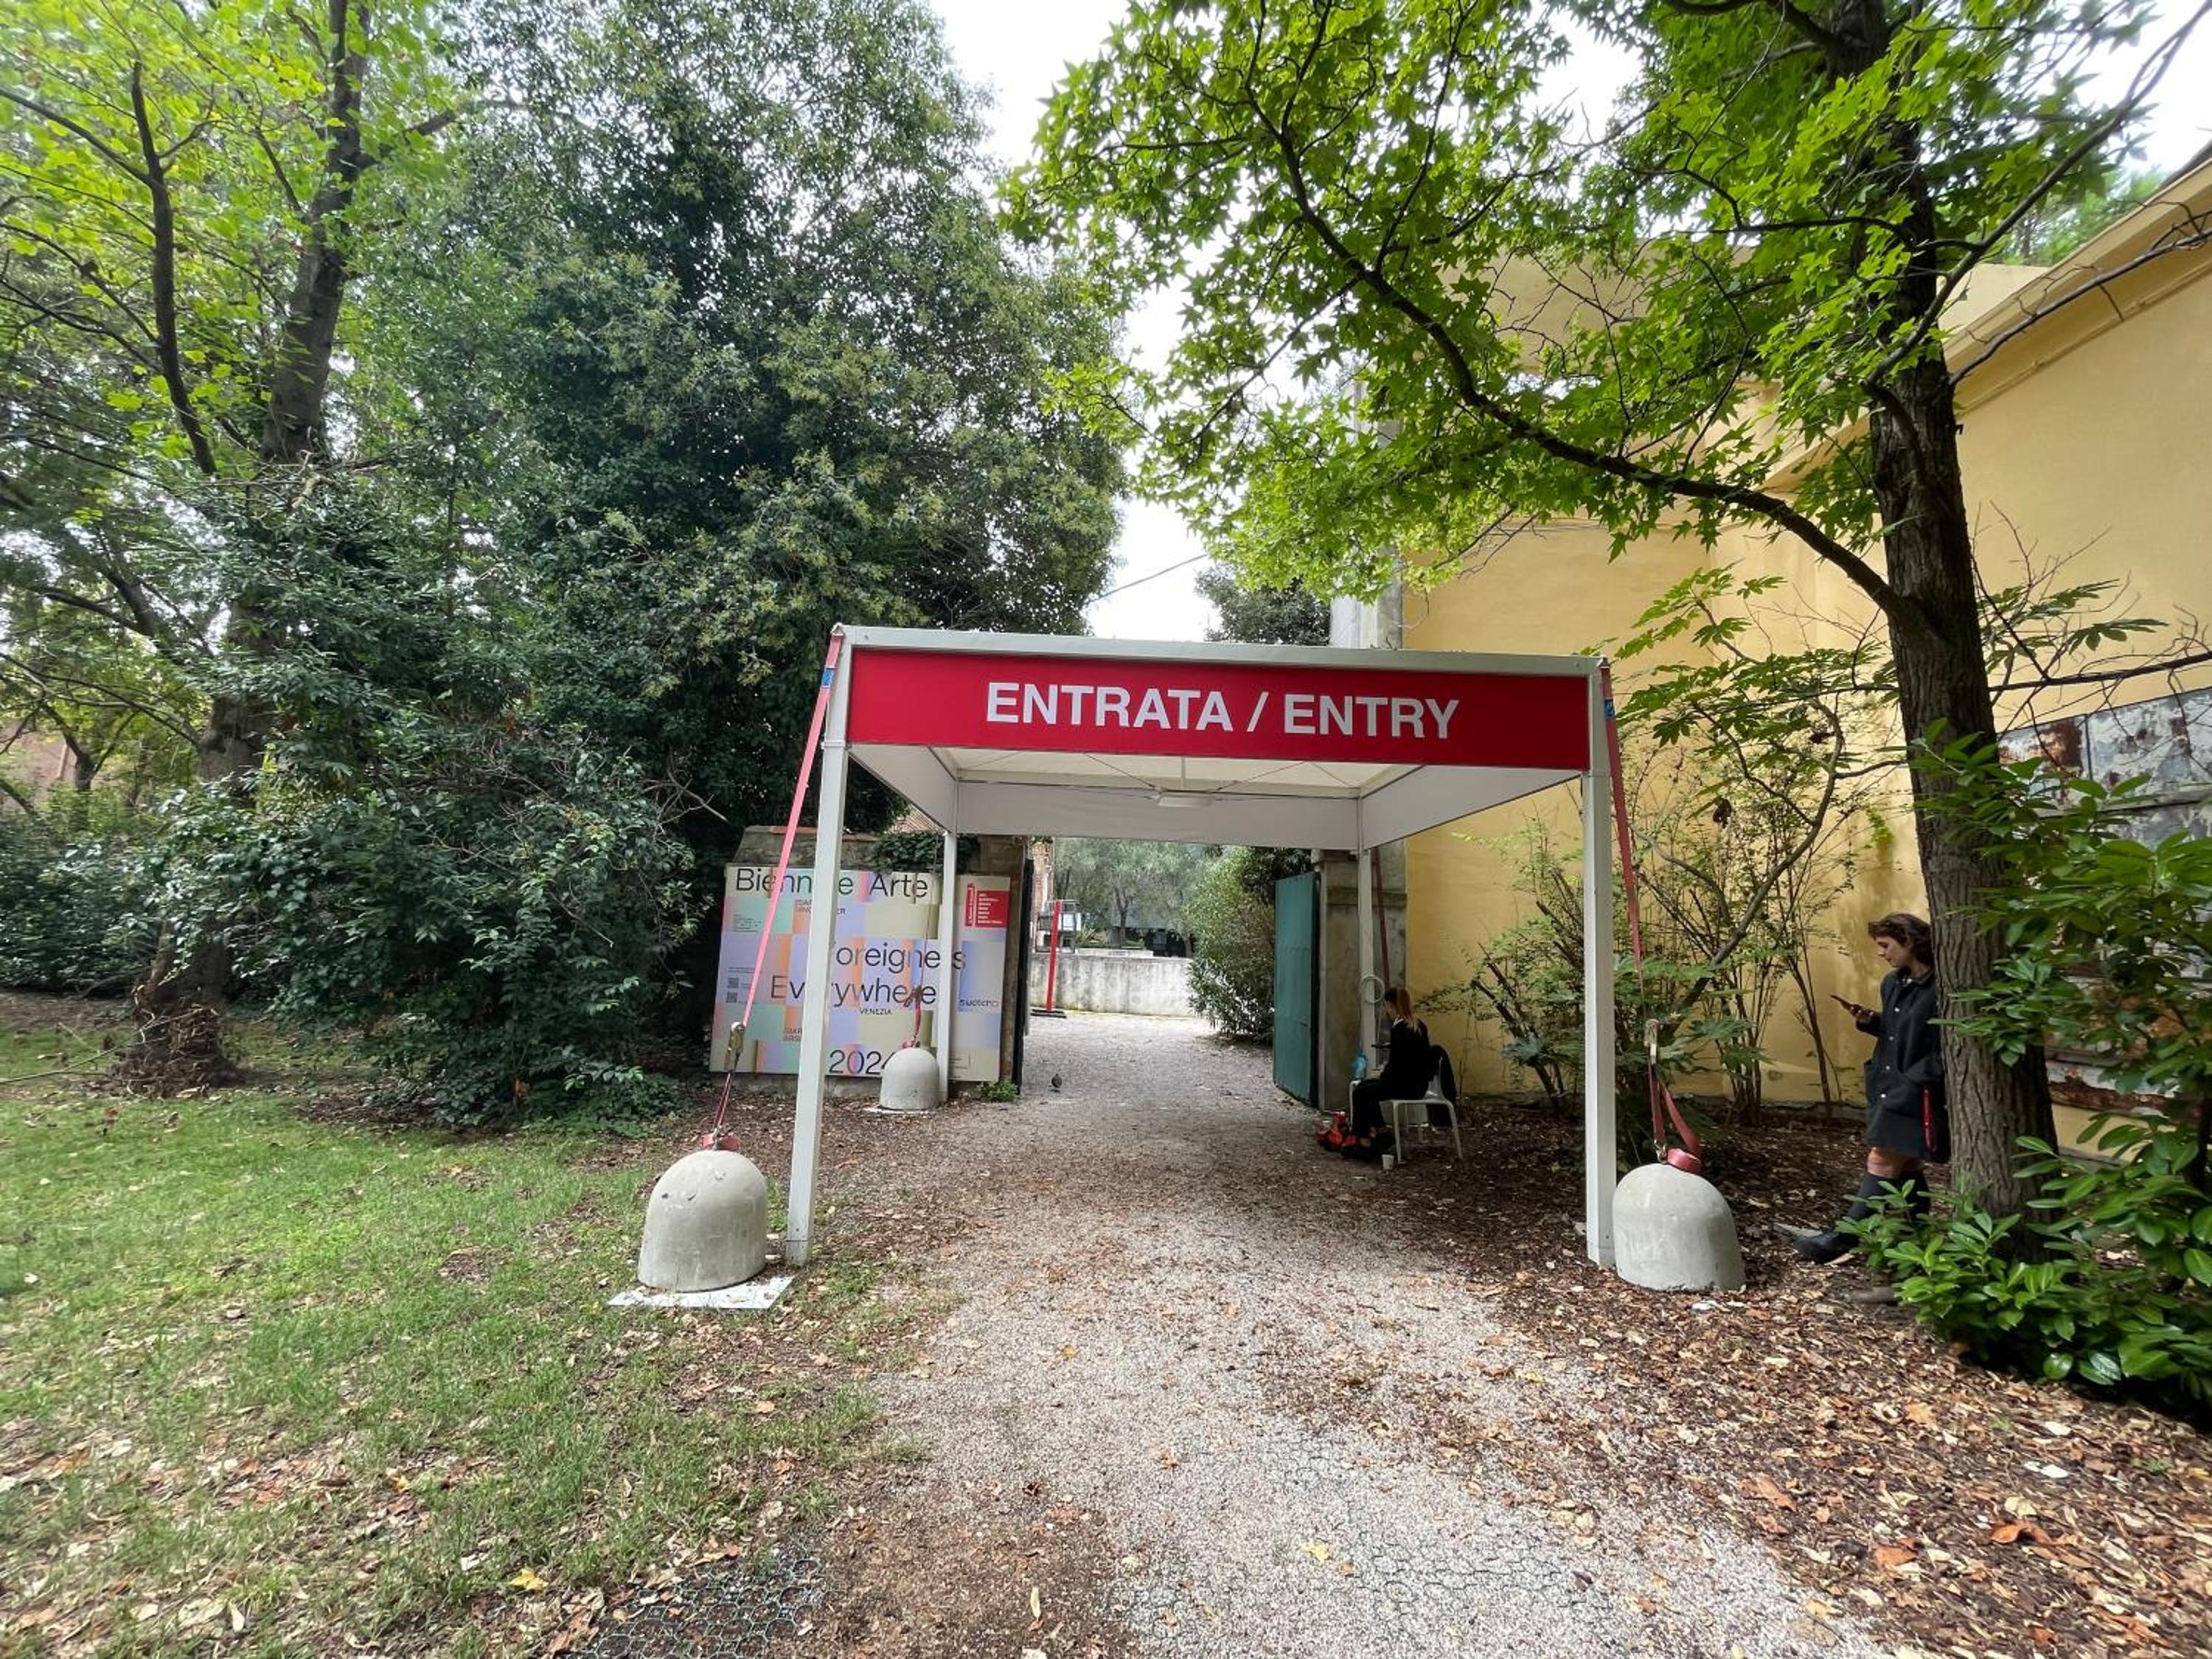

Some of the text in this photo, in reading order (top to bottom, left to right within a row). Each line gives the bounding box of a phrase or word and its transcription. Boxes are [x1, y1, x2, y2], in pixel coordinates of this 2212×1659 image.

[986, 681, 1459, 739] ENTRATA / ENTRY
[735, 868, 928, 897] Bienne Arte
[831, 942, 967, 974] oreignes
[771, 974, 937, 1008] Evywhee
[860, 1007, 893, 1015] VENEZIA
